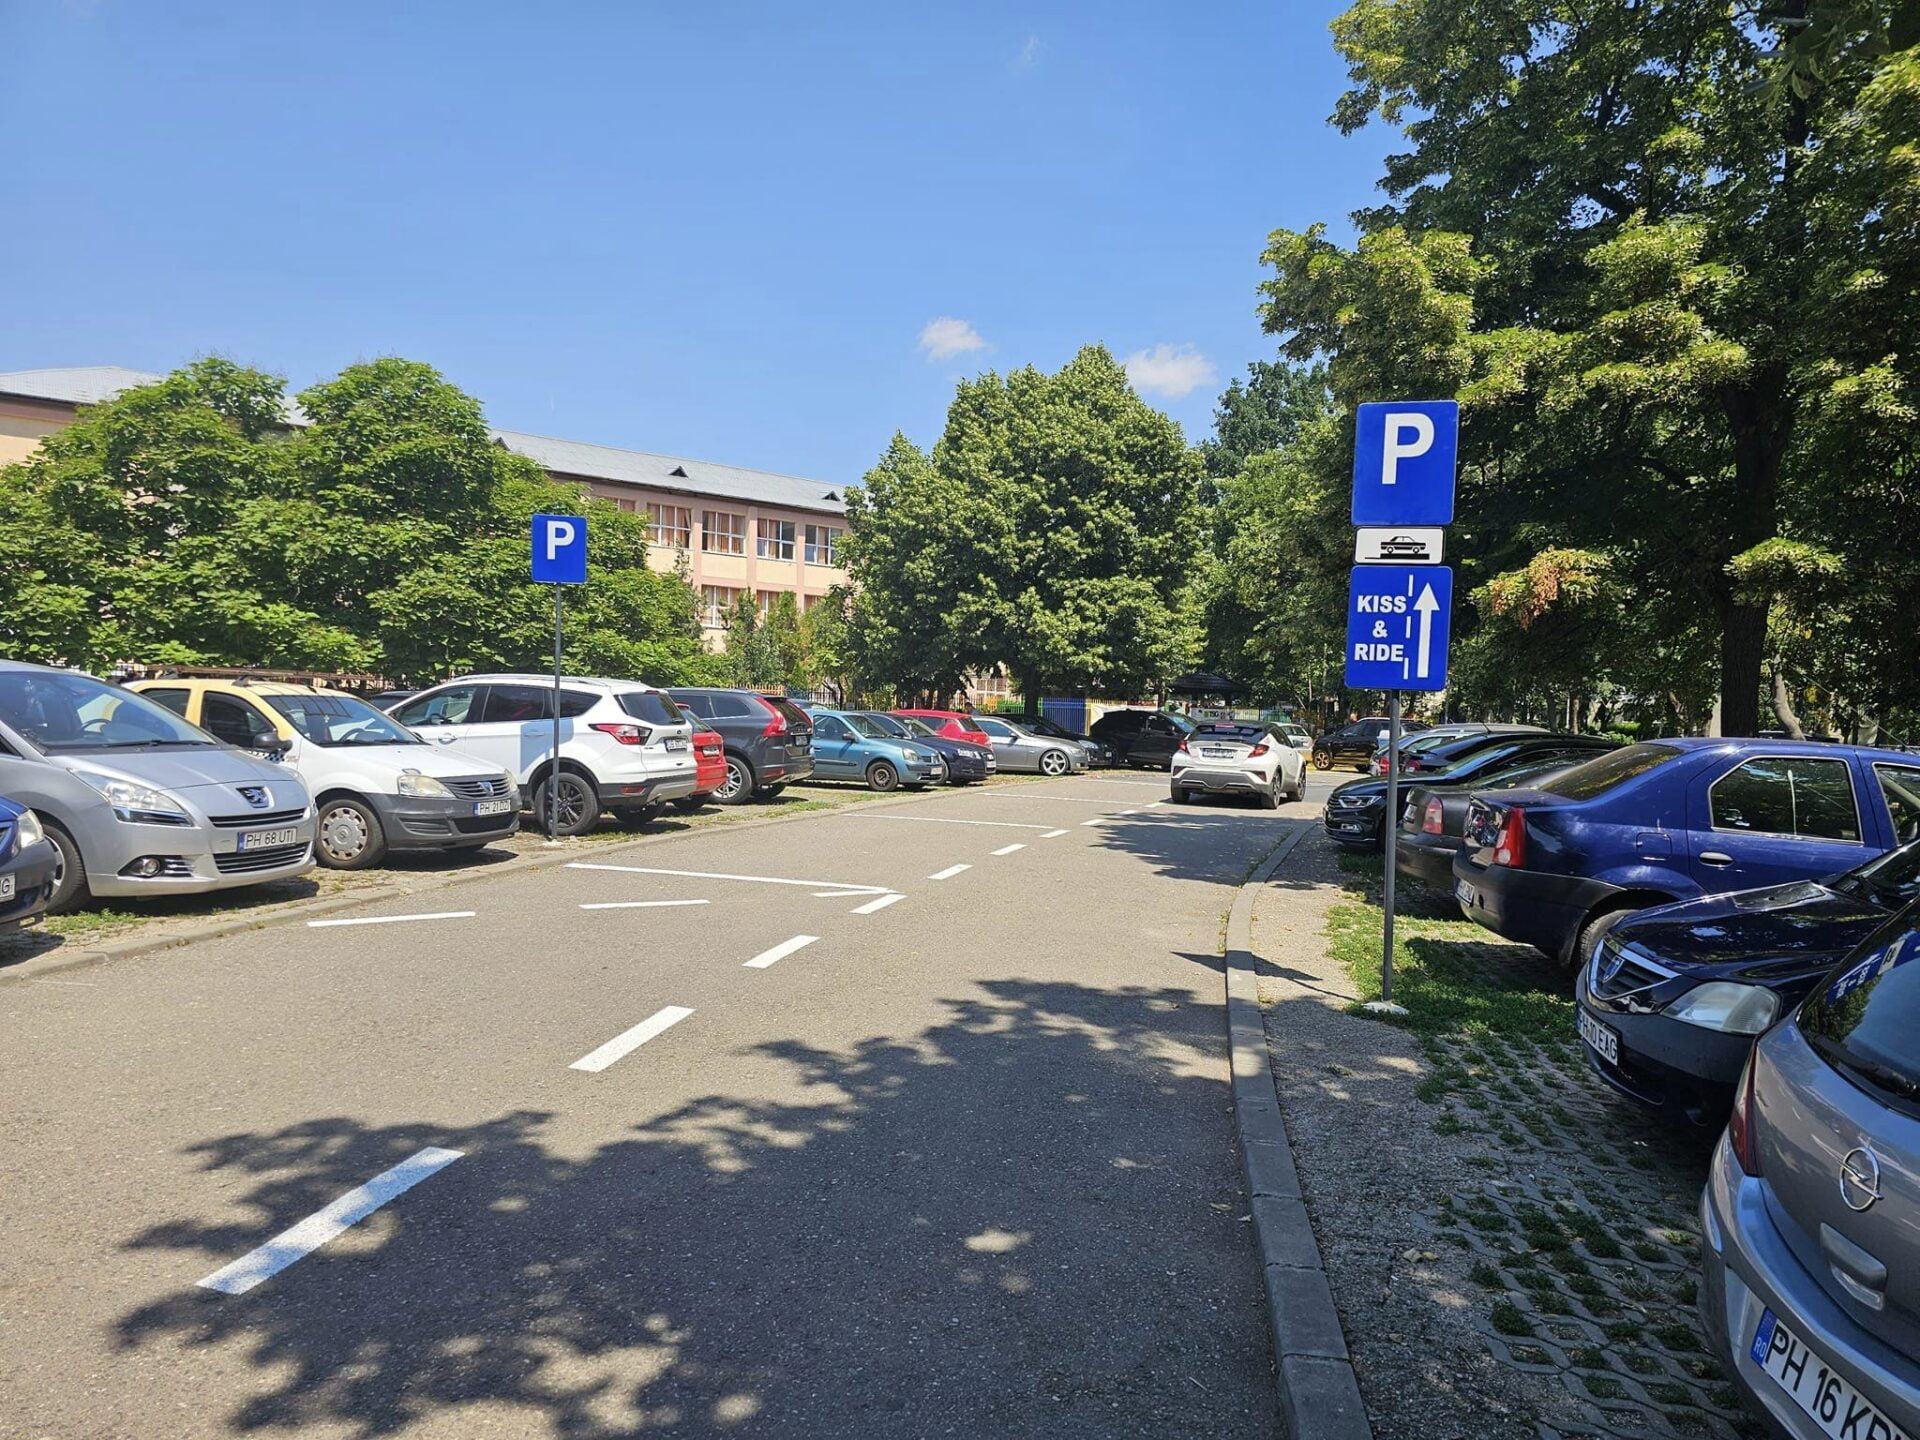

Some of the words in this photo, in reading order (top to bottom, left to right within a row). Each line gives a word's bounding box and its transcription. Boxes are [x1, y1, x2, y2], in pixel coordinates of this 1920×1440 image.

[1381, 413, 1434, 485] P
[547, 520, 575, 560] P
[1357, 595, 1407, 614] KISS
[1372, 620, 1388, 639] &
[1354, 643, 1404, 663] RIDE
[246, 833, 262, 848] PH
[265, 832, 277, 845] 68
[279, 830, 294, 843] UTI
[1598, 1029, 1617, 1060] EAG
[1754, 1337, 1767, 1357] RO
[1765, 1324, 1809, 1392] PH
[1812, 1367, 1842, 1423] 16
